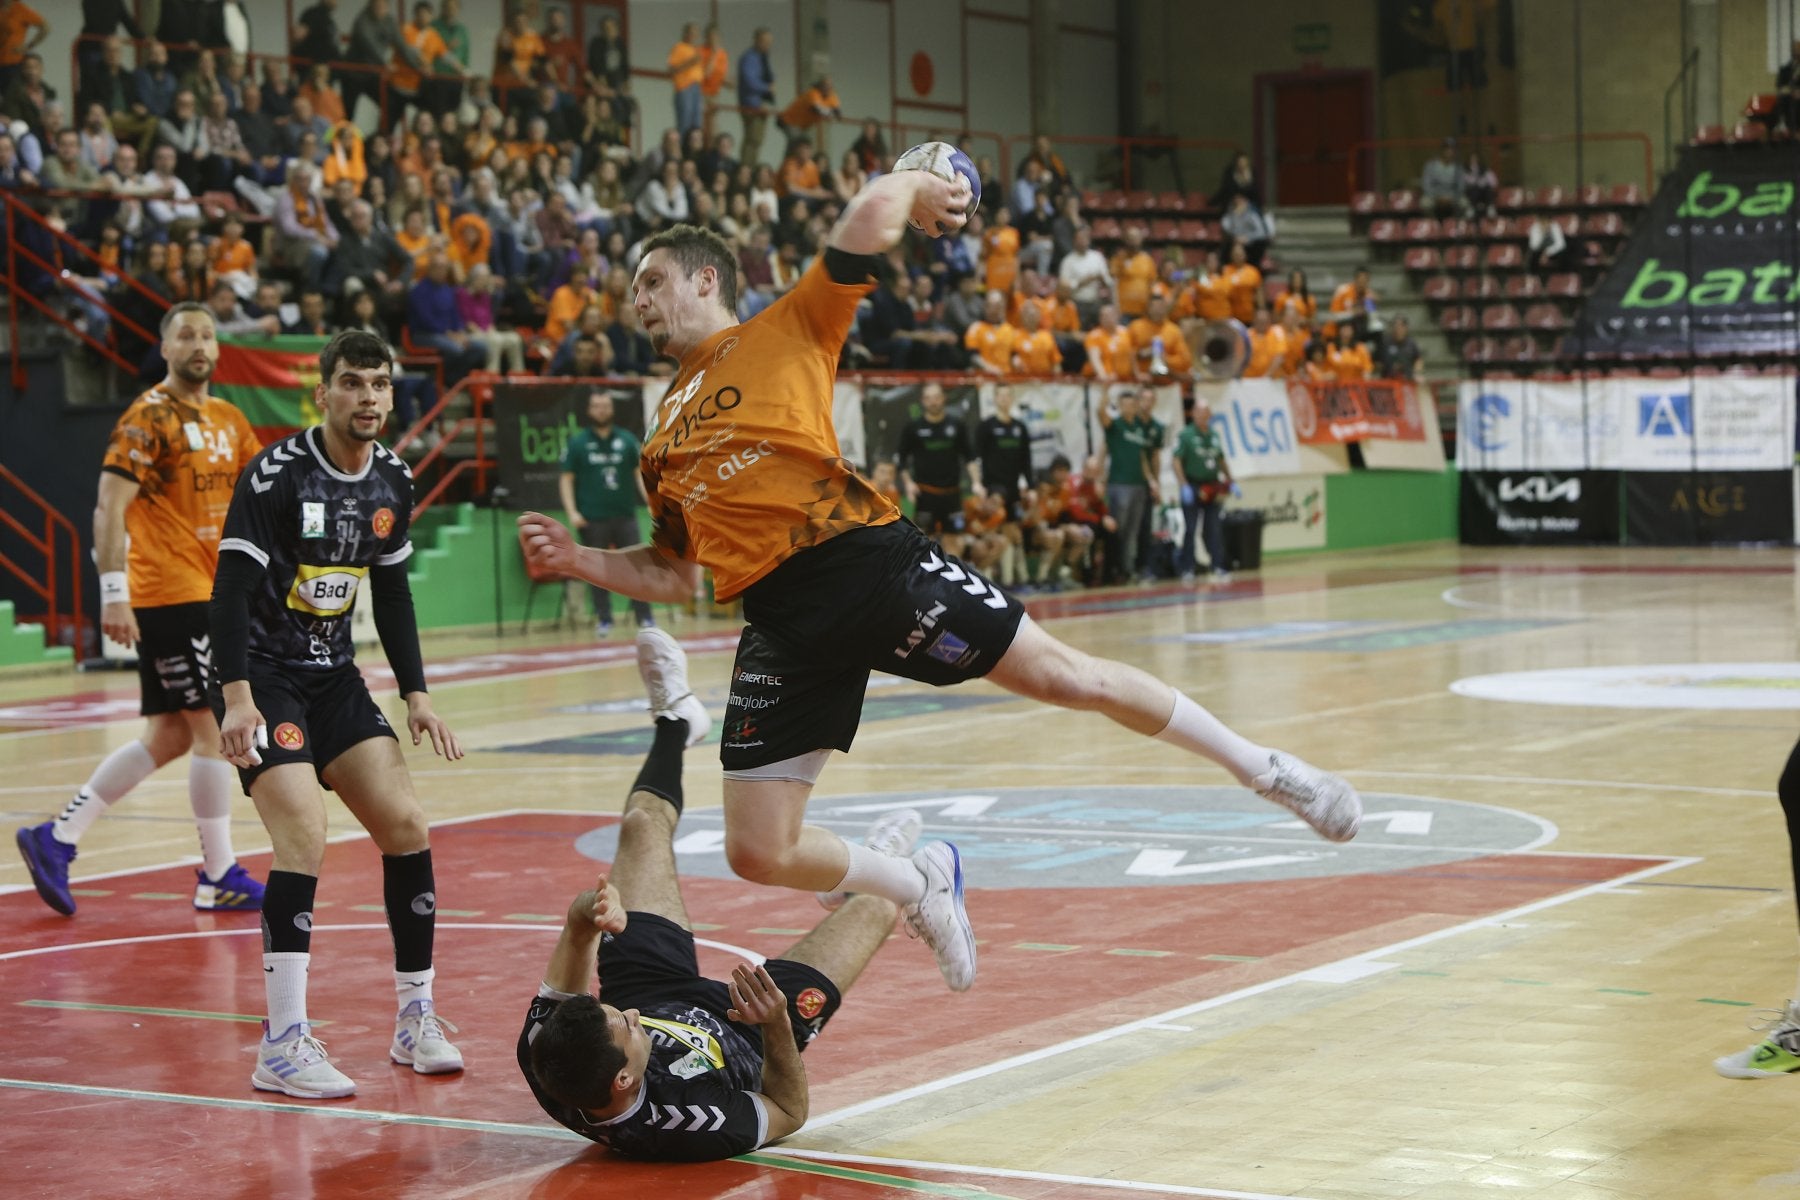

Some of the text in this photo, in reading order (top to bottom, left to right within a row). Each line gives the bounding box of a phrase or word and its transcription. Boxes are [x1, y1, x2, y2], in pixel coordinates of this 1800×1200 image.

[1676, 171, 1795, 218] ba
[1620, 258, 1800, 309] bat
[655, 386, 742, 466] athco
[203, 429, 233, 463] 34
[716, 440, 776, 481] alsa
[192, 468, 236, 492] bathc
[1499, 477, 1581, 502] KIA
[330, 520, 361, 562] 34
[314, 581, 350, 599] Bad
[738, 671, 783, 686] ENERTEC
